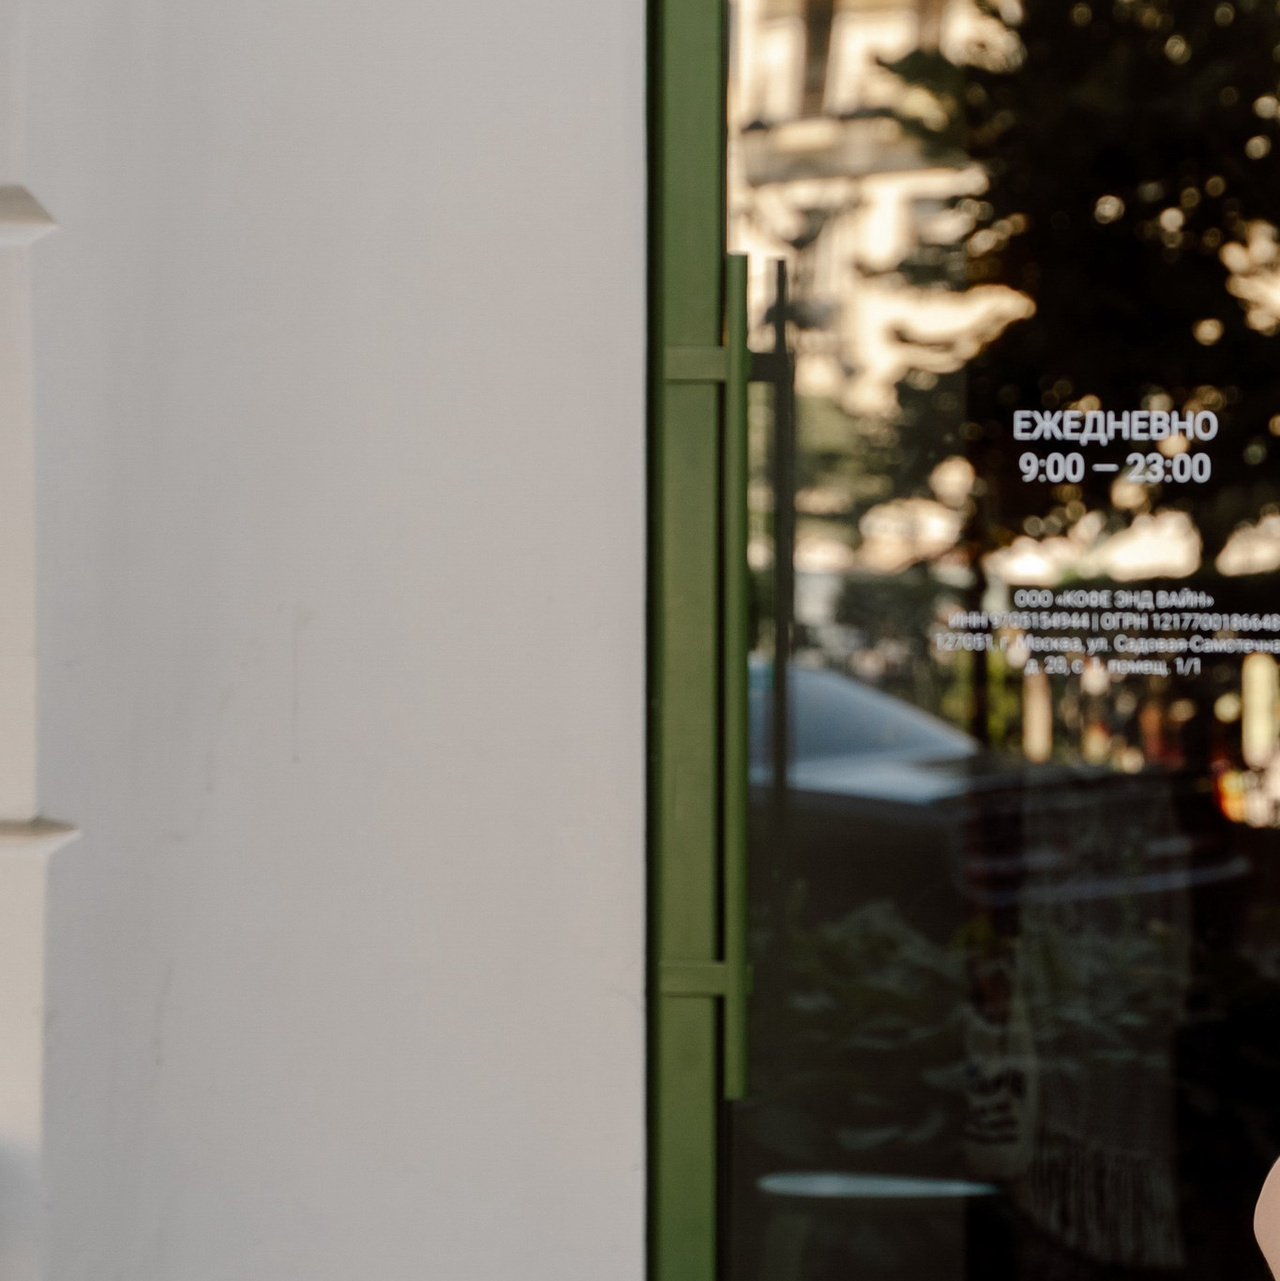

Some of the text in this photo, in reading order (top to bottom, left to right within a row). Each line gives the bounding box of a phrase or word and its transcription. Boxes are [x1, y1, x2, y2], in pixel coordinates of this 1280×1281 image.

[1013, 409, 1219, 447] ЕЖЕДНЕВНО
[1018, 451, 1085, 483] 9:00
[1125, 452, 1212, 483] 23:00
[1014, 589, 1054, 608] ООО
[1114, 589, 1155, 611] ЭНД
[948, 611, 988, 629] ИНН
[1100, 612, 1149, 630] ОГРН
[1016, 634, 1085, 654] Москва,
[1086, 637, 1112, 655] ул.
[1174, 657, 1201, 676] 1/1
